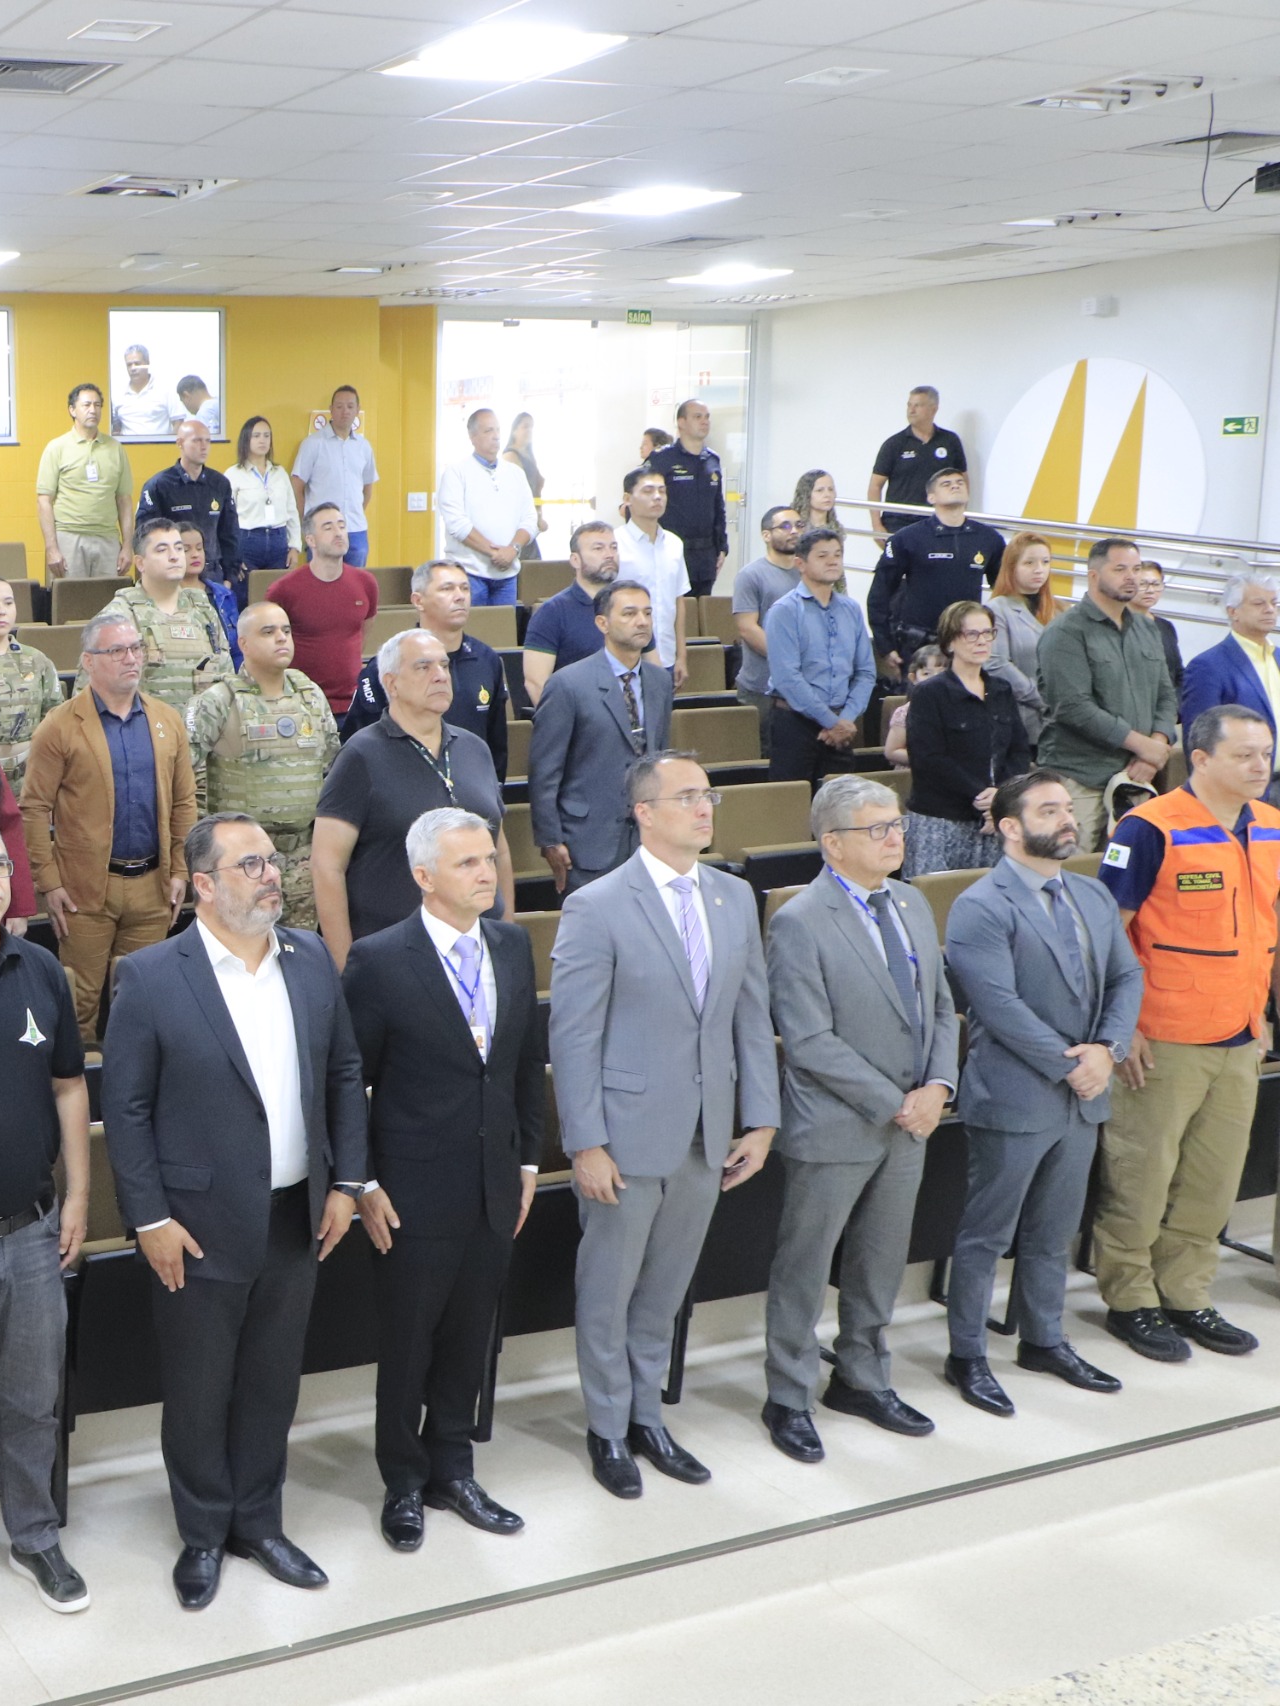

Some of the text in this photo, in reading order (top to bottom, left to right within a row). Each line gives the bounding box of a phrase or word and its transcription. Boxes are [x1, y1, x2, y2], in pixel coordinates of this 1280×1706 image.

[628, 310, 651, 323] SAÍDA
[361, 677, 375, 703] PMDF
[186, 706, 196, 732] PMDF
